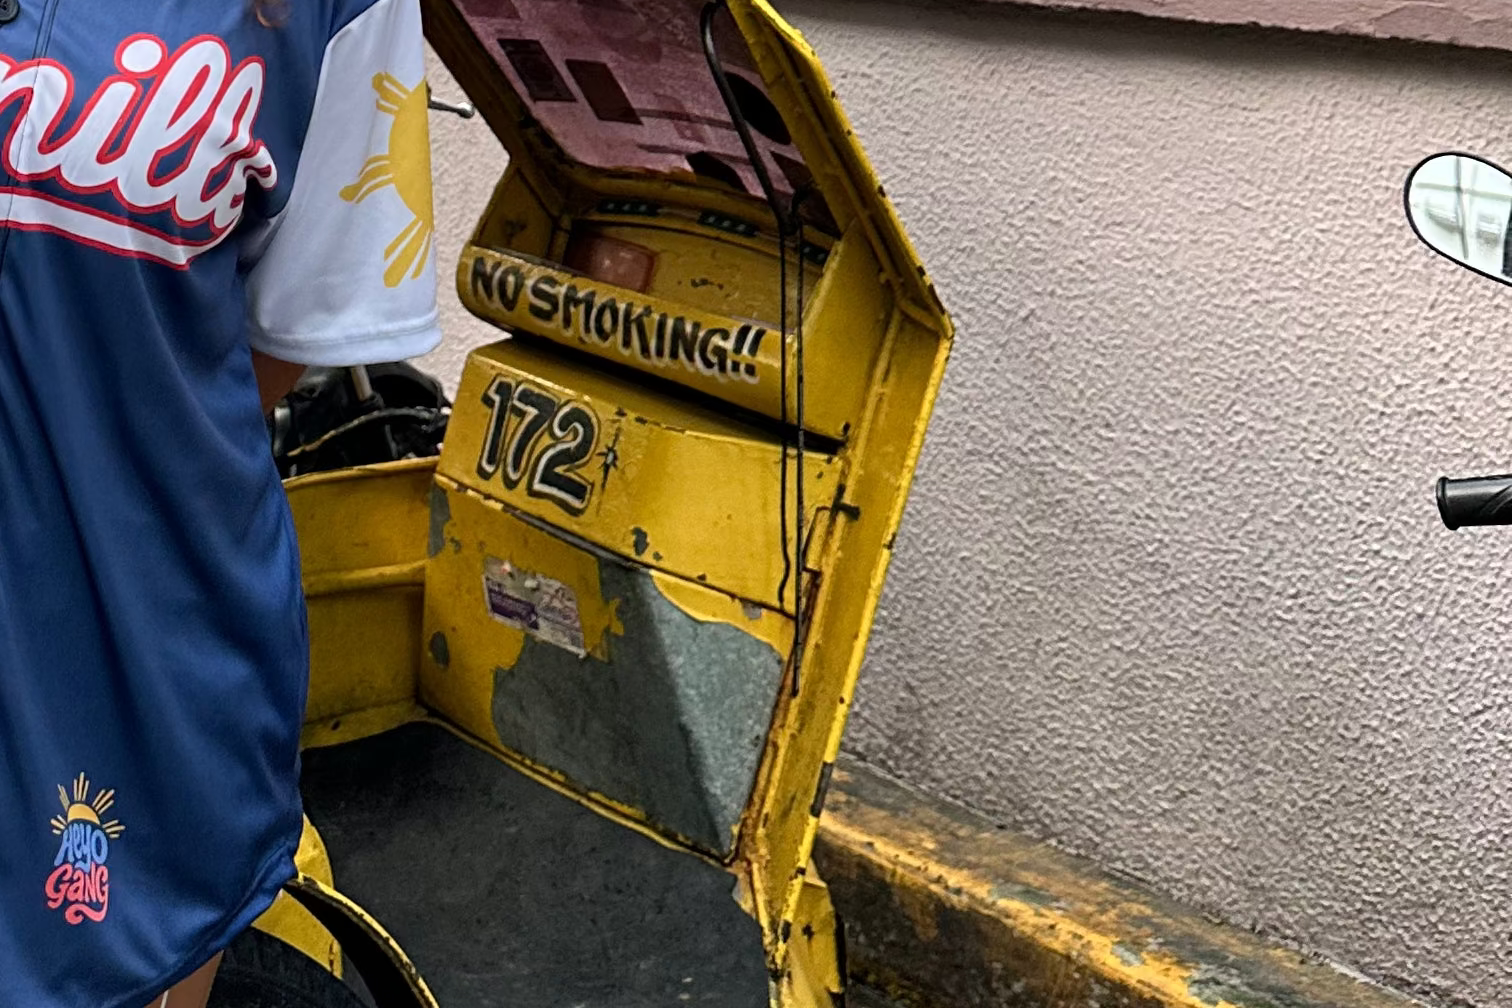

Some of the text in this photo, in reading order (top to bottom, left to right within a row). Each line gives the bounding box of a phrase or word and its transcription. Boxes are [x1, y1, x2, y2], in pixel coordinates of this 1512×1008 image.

[469, 255, 767, 385] NO SMOKING!!
[476, 373, 600, 517] 172
